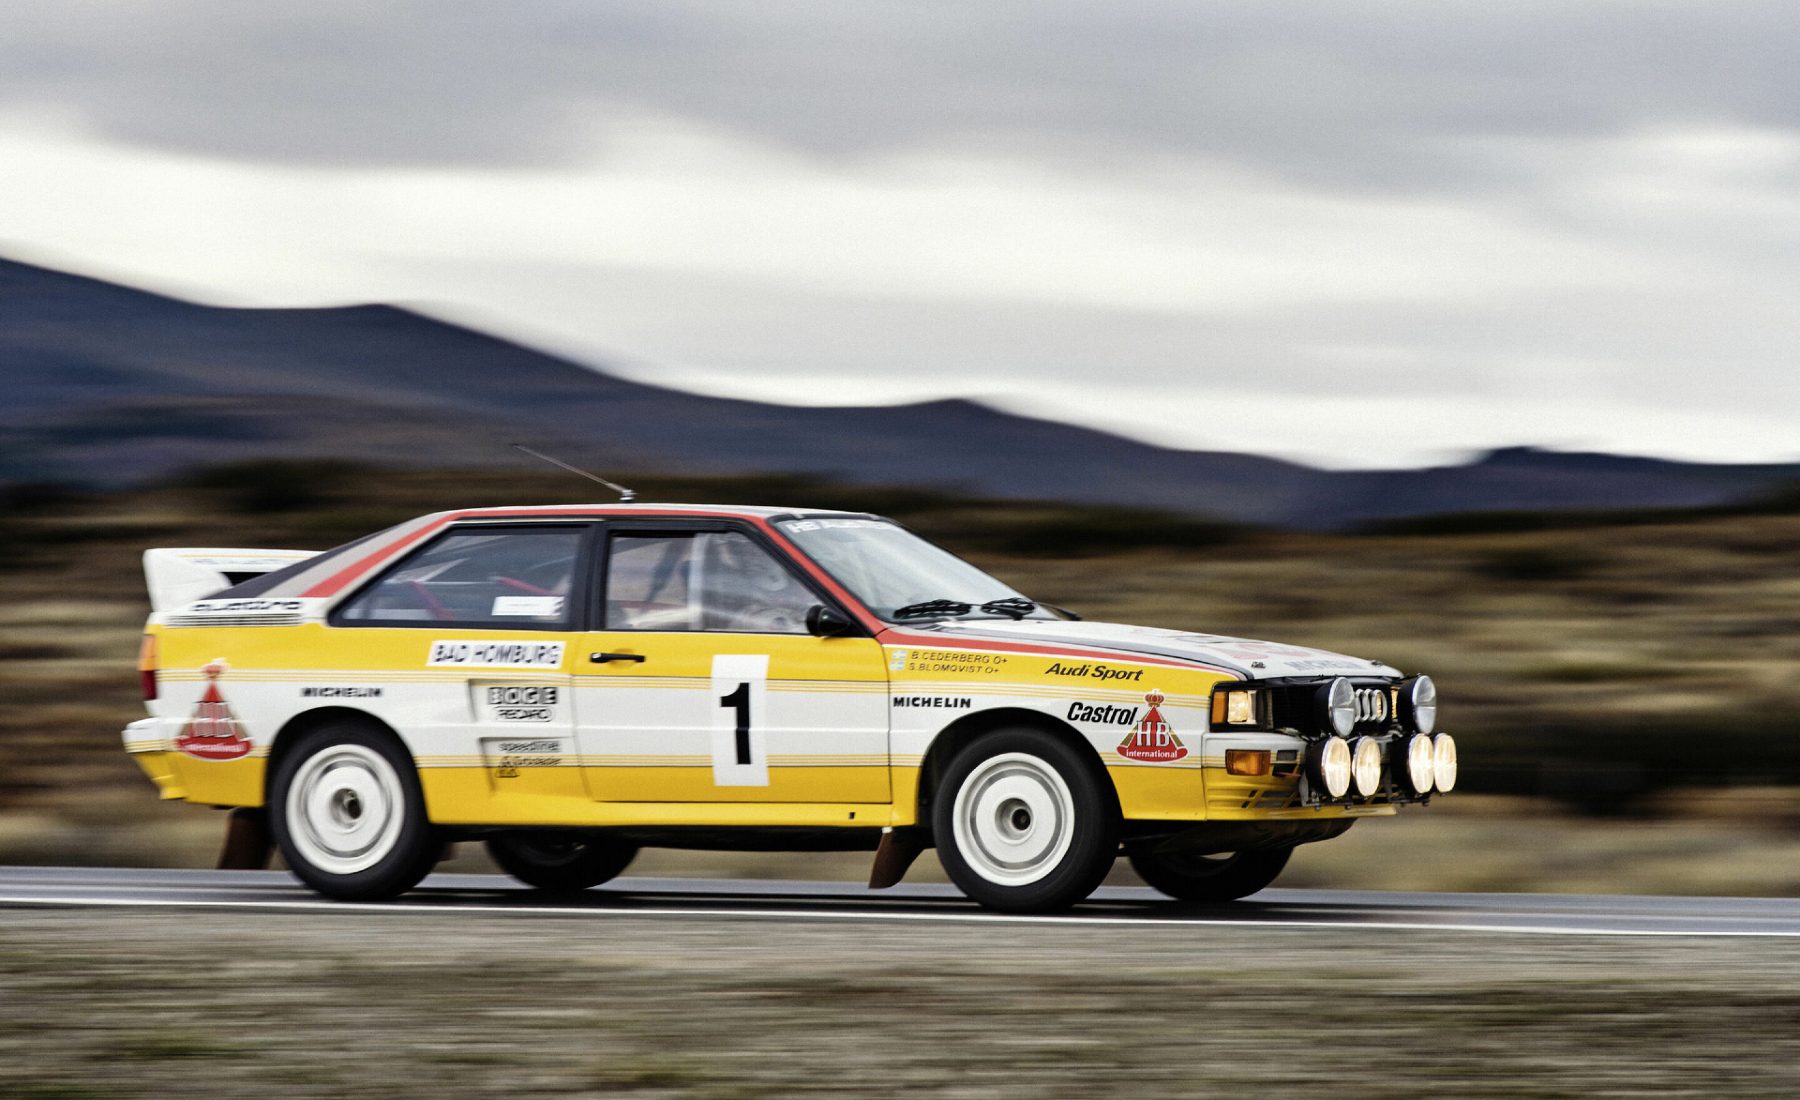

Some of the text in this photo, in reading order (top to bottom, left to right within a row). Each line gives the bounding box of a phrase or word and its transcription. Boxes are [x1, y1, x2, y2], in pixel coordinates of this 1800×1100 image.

[435, 644, 470, 663] BAD
[1045, 662, 1143, 681] Audi Sport
[302, 687, 383, 698] MICHELIN
[893, 696, 971, 708] MICHELIN
[1066, 701, 1138, 725] Castrol
[720, 682, 751, 765] 1
[1136, 720, 1171, 747] HB
[1126, 748, 1178, 759] international
